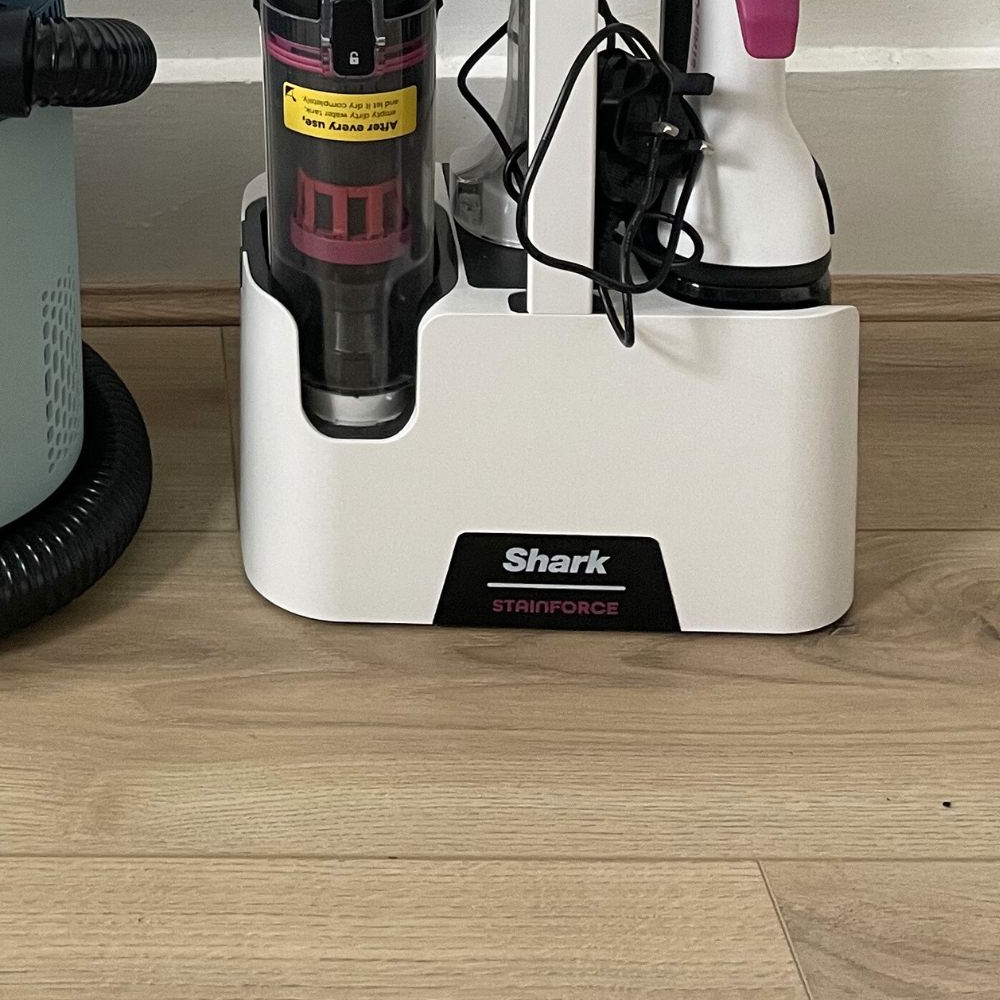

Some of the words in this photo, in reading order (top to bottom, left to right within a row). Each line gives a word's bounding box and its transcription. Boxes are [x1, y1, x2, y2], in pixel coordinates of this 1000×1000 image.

[349, 102, 363, 110] dry
[365, 102, 371, 110] it
[373, 101, 383, 110] let
[384, 100, 399, 109] and
[325, 111, 347, 119] water
[350, 111, 370, 120] dirty
[372, 109, 397, 119] empty
[302, 116, 325, 128] use,
[328, 121, 364, 132] every
[367, 120, 398, 132] After
[502, 547, 611, 574] Shark
[492, 599, 619, 615] STAINFORCE
